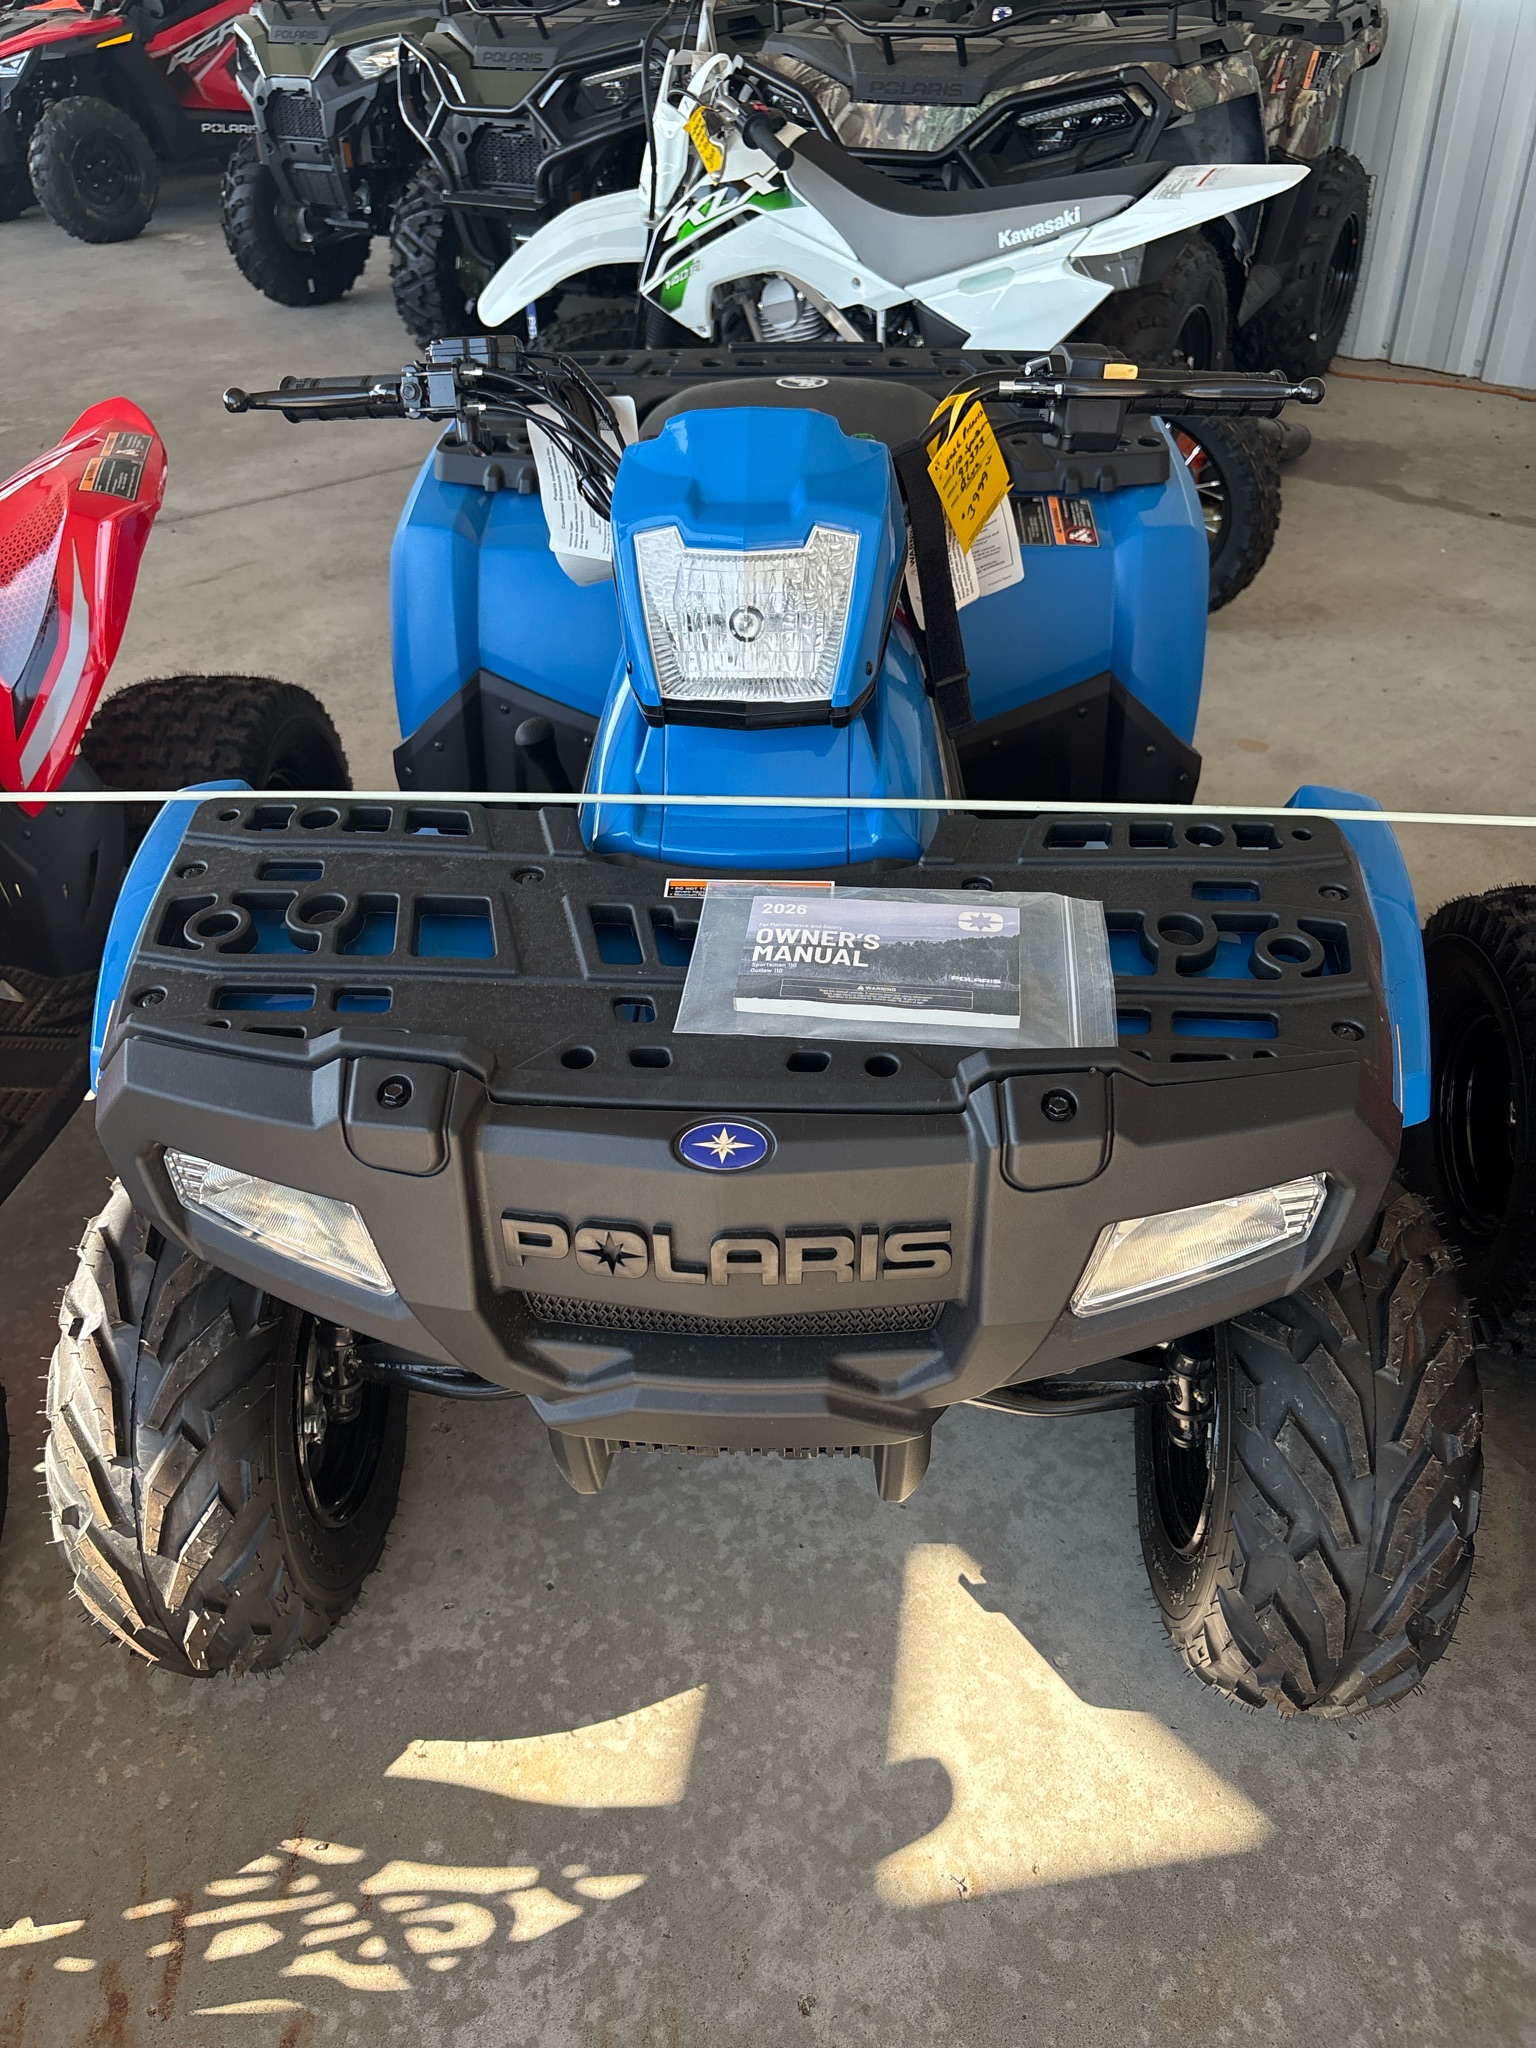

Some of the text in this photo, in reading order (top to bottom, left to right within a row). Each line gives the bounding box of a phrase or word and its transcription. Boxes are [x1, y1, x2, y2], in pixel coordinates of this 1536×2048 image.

[274, 29, 320, 40] POLARIS
[482, 51, 544, 64] POLARIS
[869, 80, 965, 97] POLARIS
[998, 205, 1082, 249] Kawasaki
[762, 903, 808, 915] 2026
[756, 928, 880, 950] OWNER'S
[752, 945, 869, 967] MANUAL
[951, 975, 1001, 984] POLARIS
[501, 1210, 953, 1286] POLARIS
